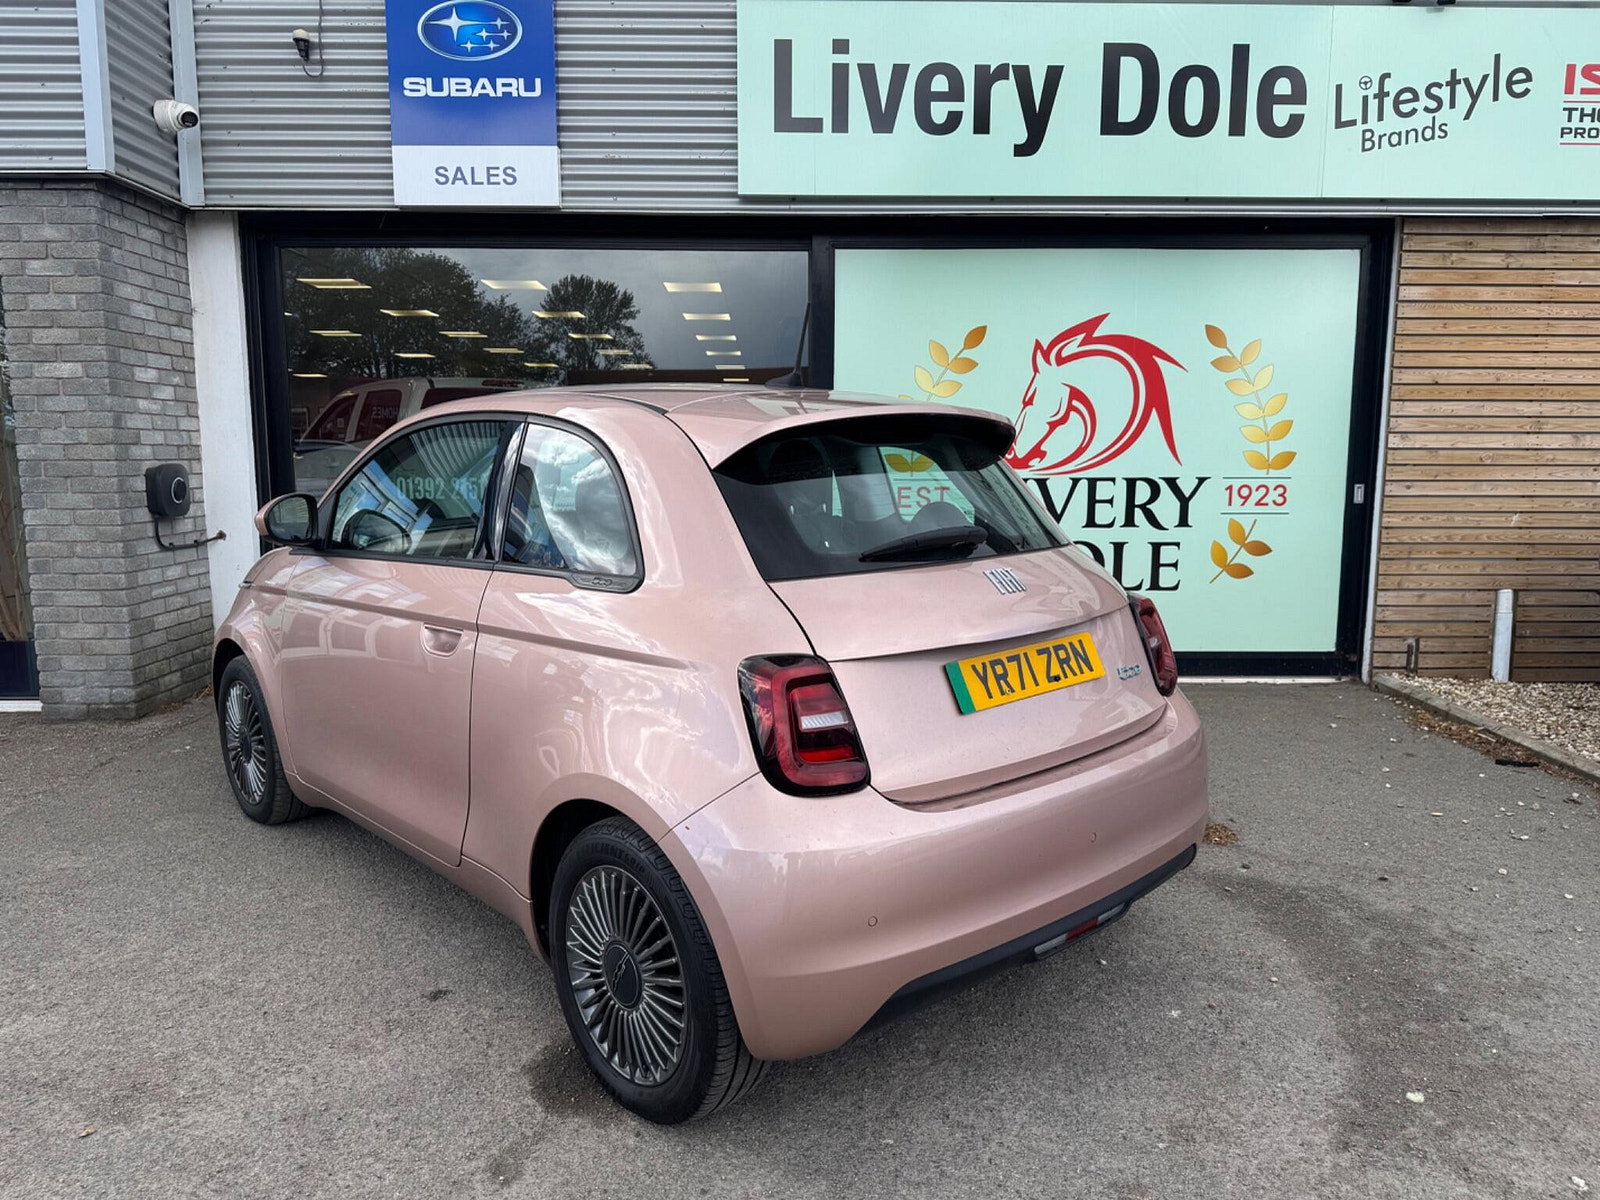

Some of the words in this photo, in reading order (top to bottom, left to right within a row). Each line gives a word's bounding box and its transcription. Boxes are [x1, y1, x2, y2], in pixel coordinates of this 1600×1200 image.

[403, 77, 542, 98] SUBARU
[773, 38, 1064, 157] Livery
[1099, 42, 1308, 139] Dole
[1334, 53, 1533, 130] Lifestyle
[1562, 107, 1600, 123] TH
[1361, 116, 1449, 153] Brands
[434, 166, 518, 186] SALES
[895, 485, 951, 508] EST
[1023, 477, 1210, 531] VERY
[1225, 484, 1288, 508] 1923
[970, 652, 1040, 700] YR71
[1037, 639, 1095, 684] ZRN
